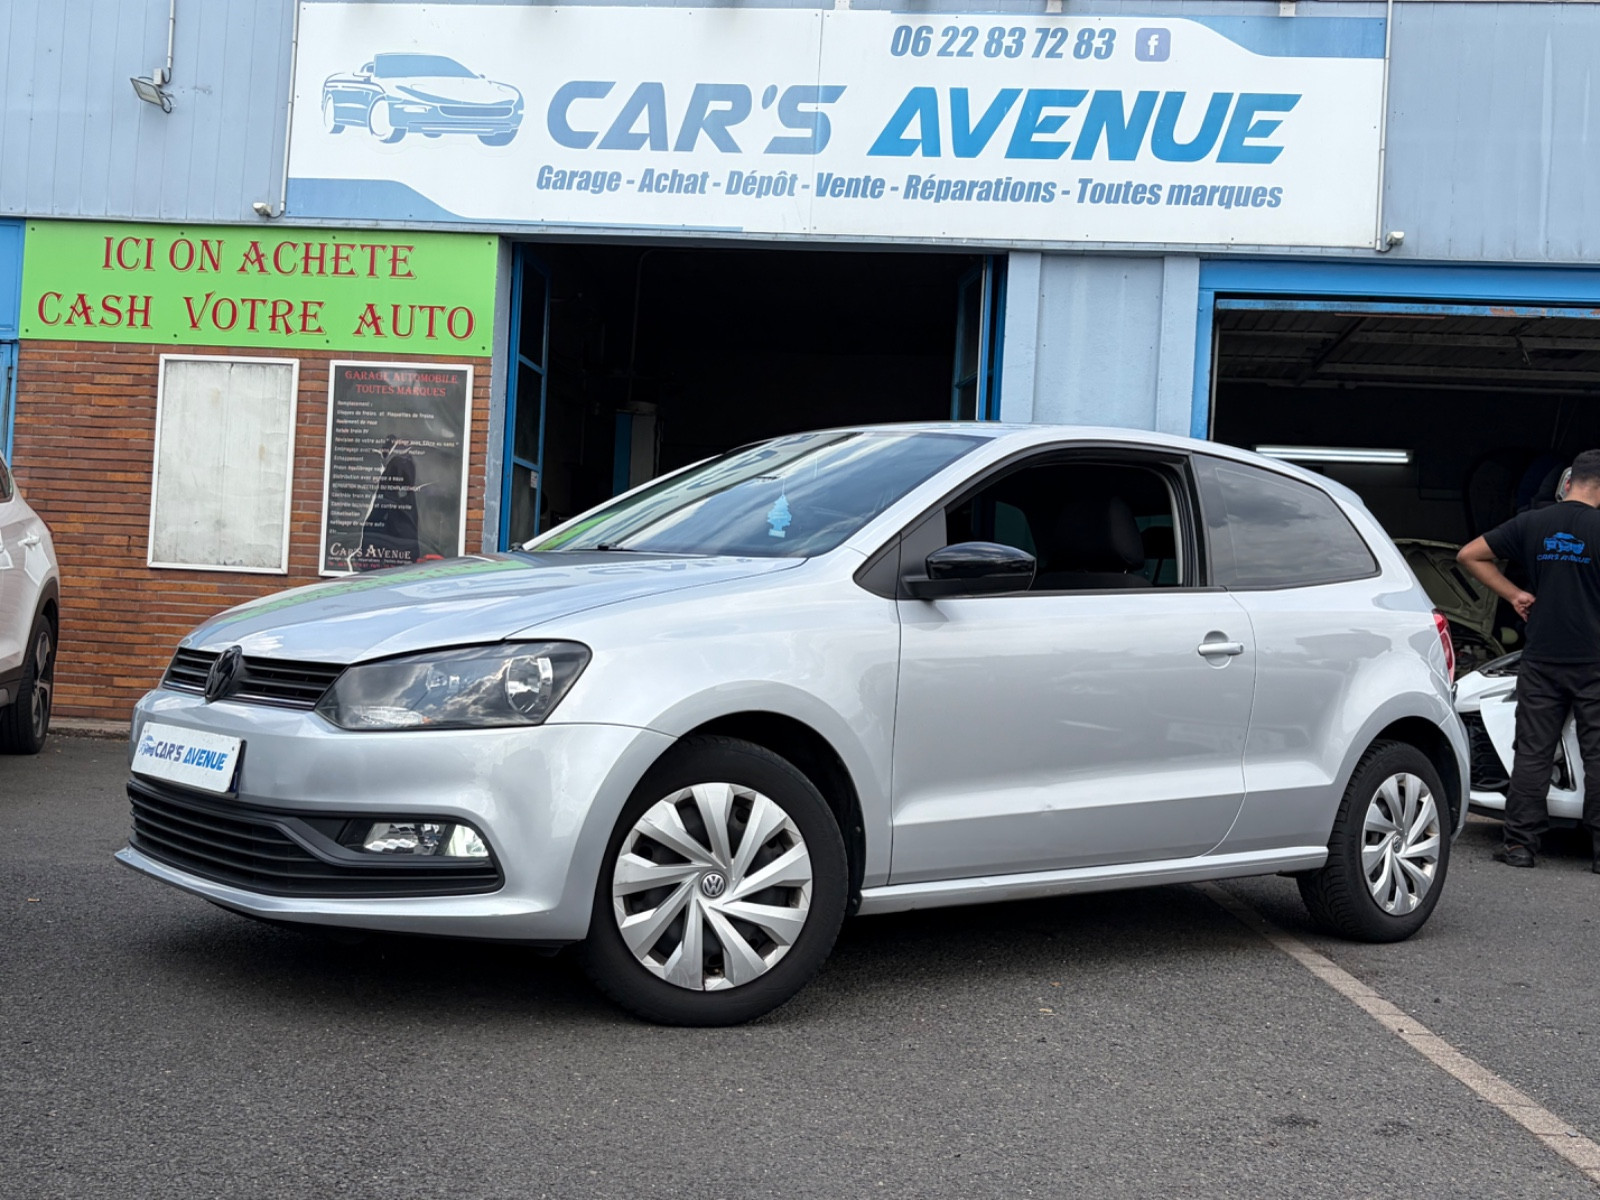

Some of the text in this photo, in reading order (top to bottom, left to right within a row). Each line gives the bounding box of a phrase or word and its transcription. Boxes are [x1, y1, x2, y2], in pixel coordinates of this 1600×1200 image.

[890, 25, 1116, 60] 06 22 83 72 83
[546, 80, 1303, 164] CAR'S AVENUE
[536, 164, 622, 193] Garage
[637, 167, 709, 195] Achat
[726, 168, 799, 199] Dépôt
[815, 172, 885, 199] Vente
[903, 173, 1056, 204] Réparations
[1077, 177, 1163, 206] Toutes
[1165, 181, 1284, 210] marques
[102, 236, 417, 280] ICI ON ACHETE
[37, 290, 477, 341] CASH VOTRE AUTO
[345, 370, 459, 384] GARAGE AUTOMOBILE
[355, 384, 447, 397] TOUTES MARQUES
[154, 741, 229, 771] CAR'S AVENUE
